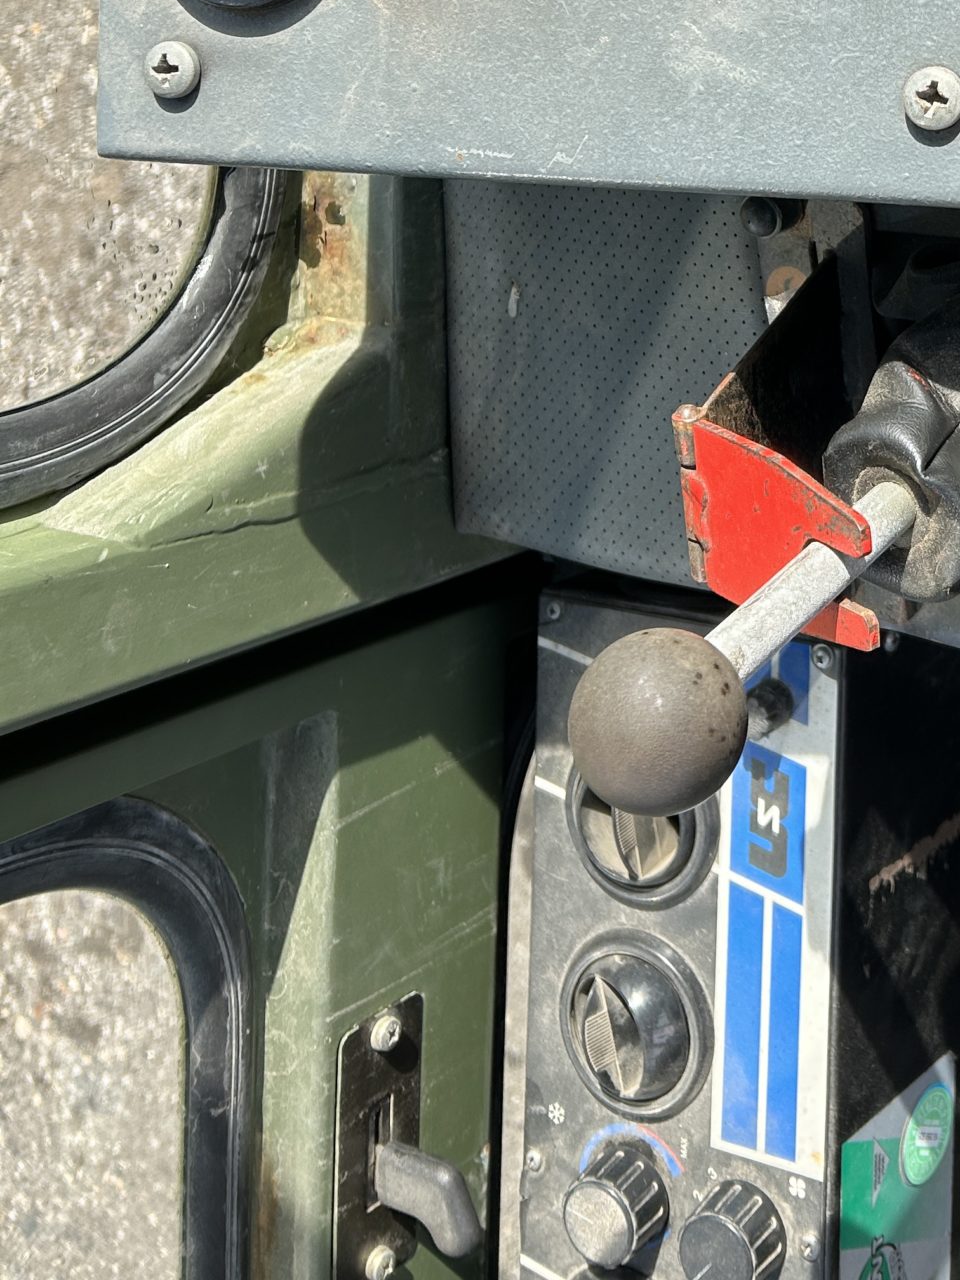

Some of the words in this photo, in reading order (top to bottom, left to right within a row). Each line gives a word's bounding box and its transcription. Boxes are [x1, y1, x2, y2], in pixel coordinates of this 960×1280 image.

[680, 1136, 688, 1160] MAX
[693, 1189, 704, 1202] 2
[707, 1167, 718, 1181] 3
